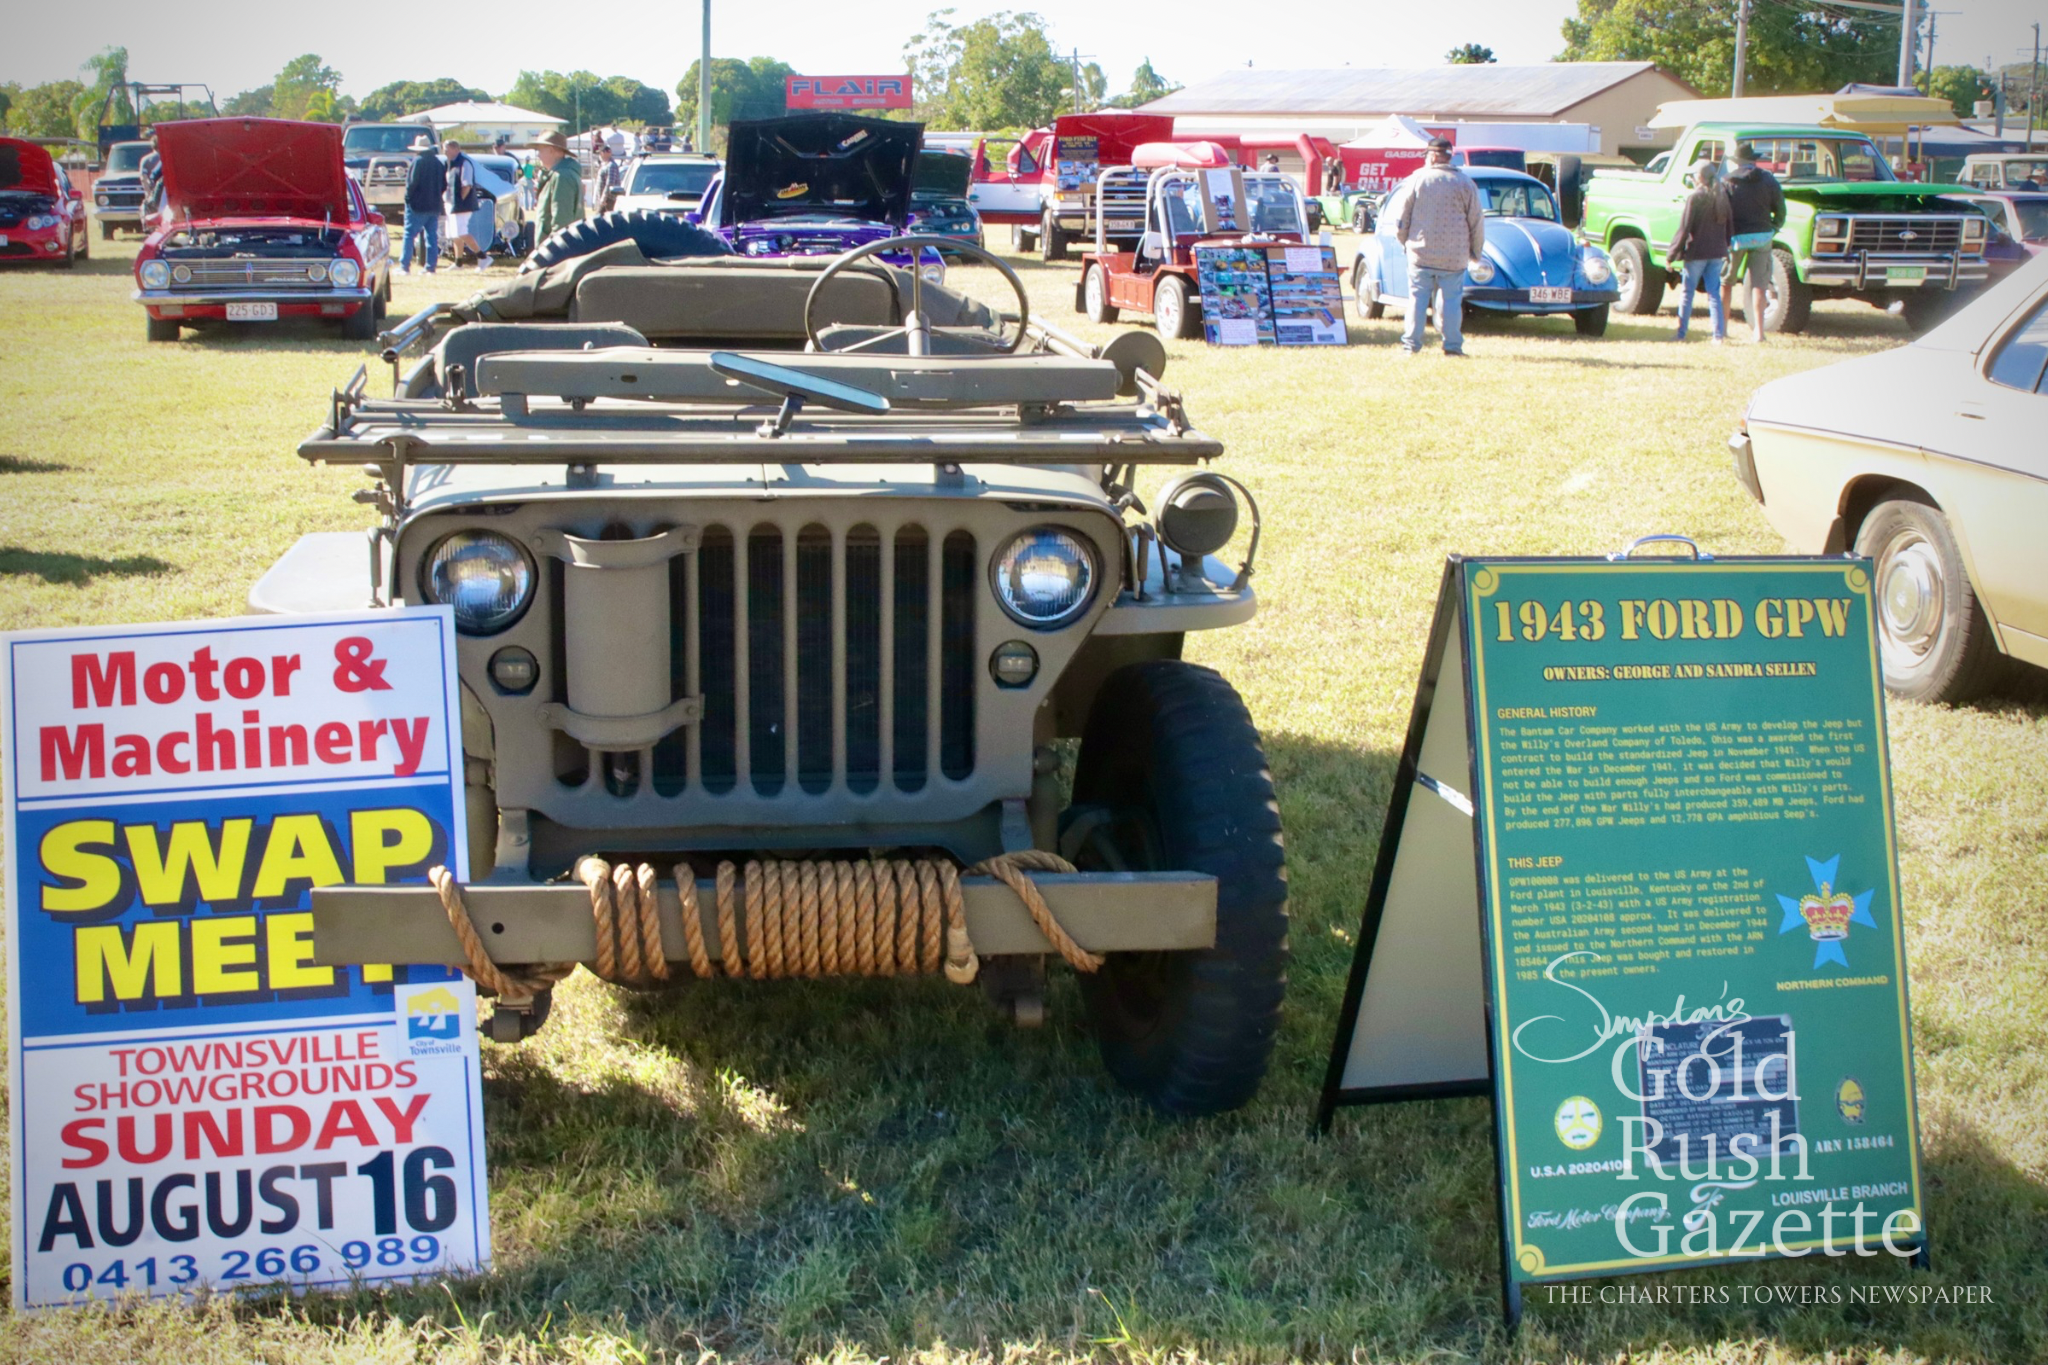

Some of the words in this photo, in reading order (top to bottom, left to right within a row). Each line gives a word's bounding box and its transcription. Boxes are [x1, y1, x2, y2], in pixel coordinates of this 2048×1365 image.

[1384, 150, 1425, 159] GASGA
[1359, 162, 1389, 176] GET
[1357, 176, 1380, 190] ON
[1494, 599, 1606, 642] 1943
[1618, 598, 1744, 641] FORD
[1754, 597, 1852, 639] GPW
[70, 645, 301, 710] Motor
[332, 636, 395, 694] &
[1543, 665, 1611, 681] OWNERS:
[1612, 664, 1672, 680] GEORGE
[1673, 663, 1704, 679] AND
[1706, 662, 1764, 678] SANDRA
[1765, 661, 1817, 677] SELLEN
[1497, 706, 1548, 720] GENERAL
[1549, 705, 1598, 719] HISTORY
[39, 709, 431, 782] Machinery
[1564, 738, 1607, 748] Overland
[1501, 753, 1544, 763] contract
[1619, 749, 1682, 759] standardized
[1728, 746, 1769, 756] November
[1603, 763, 1646, 773] December
[1766, 770, 1827, 780] commissioned
[1674, 785, 1751, 799] interchangeable
[1685, 799, 1727, 811] produced
[1505, 819, 1549, 832] produced
[1728, 810, 1779, 823] amphibious
[39, 807, 434, 912] SWAP
[1507, 856, 1534, 869] THIS
[1536, 855, 1563, 868] JEEP
[1585, 872, 1633, 883] delivered
[1649, 882, 1691, 895] Kentucky
[1698, 892, 1761, 906] registration
[1704, 905, 1751, 916] delivered
[1534, 927, 1588, 939] Australian
[1700, 919, 1742, 930] December
[1610, 937, 1653, 948] Northern
[75, 911, 394, 1003] MEE
[1696, 946, 1739, 957] restored
[1776, 978, 1834, 991] NORTHERN
[1835, 975, 1889, 988] COMMAND
[109, 1031, 380, 1078] TOWNSVILLE
[409, 1043, 462, 1056] Townsville
[74, 1060, 418, 1113] SHOWGROUNDS
[60, 1093, 432, 1169] SUNDAY
[1814, 1138, 1842, 1154] ARN
[1530, 1164, 1566, 1178] U.S.A
[37, 1161, 347, 1253] AUGUST
[357, 1145, 458, 1236] 16
[1771, 1187, 1849, 1206] LOUISVILLE
[1851, 1181, 1909, 1199] BRANCH
[1527, 1210, 1562, 1229] Ford
[1556, 1208, 1601, 1230] Motor
[62, 1254, 199, 1293] 0413
[220, 1244, 321, 1281] 266
[340, 1235, 440, 1270] 989
